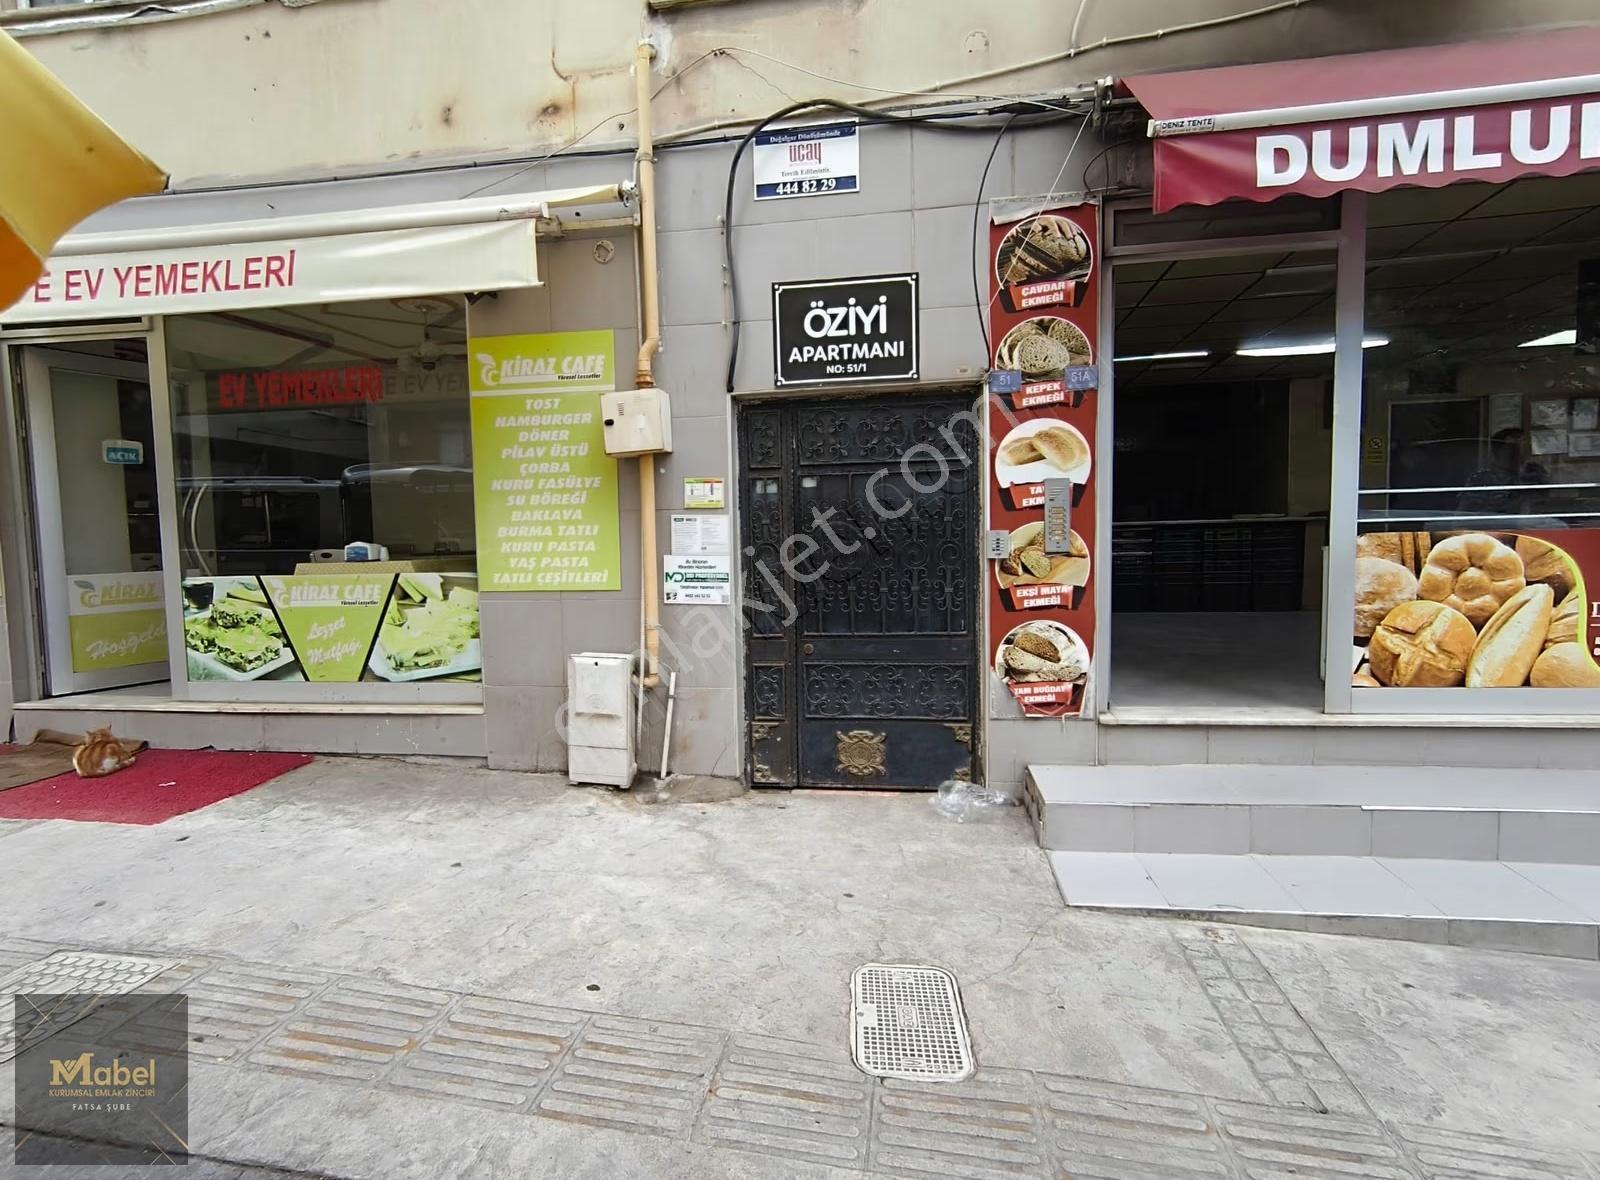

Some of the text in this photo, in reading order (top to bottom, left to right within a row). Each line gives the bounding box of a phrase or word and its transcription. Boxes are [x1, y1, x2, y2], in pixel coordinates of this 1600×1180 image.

[1187, 118, 1213, 127] TENTE
[776, 178, 837, 196] 444 82 29
[64, 268, 105, 301] EV
[113, 249, 296, 298] YEMEKLERİ
[1021, 290, 1065, 308] EKMEĞİ
[803, 295, 888, 339] ÖZİYİ
[788, 341, 906, 364] APARTMANI
[501, 354, 605, 377] KİRAZ CAFE
[826, 363, 867, 374] NO: 51/1
[999, 375, 1011, 386] 51
[1071, 371, 1091, 383] 51A
[1025, 382, 1061, 394] KEPEK
[525, 398, 561, 410] TOST
[1022, 391, 1064, 406] EKMEĞİ
[495, 412, 593, 427] HAMBURGER
[518, 428, 570, 442] DÖNER
[502, 441, 590, 459] PİLAV ÜSTÜ
[519, 462, 571, 476] ÇORBA
[490, 474, 602, 491] KURU FASÜLYE
[506, 489, 588, 506] SU BÖREĞİ
[511, 509, 583, 522] BAKLAVA
[497, 524, 600, 538] BURMA TATLI
[500, 540, 597, 553] KURU PASTA
[509, 556, 590, 571] YAŞ PASTA
[493, 568, 609, 586] TATLI ÇEŞİTLERİ
[100, 580, 158, 600] KİRAZ
[289, 581, 382, 600] KİRAZ CAFE
[1016, 585, 1068, 598] EKŞİ MAYA
[1023, 594, 1061, 608] EKMEĞİ
[1033, 684, 1066, 694] BUĞDAY
[1024, 694, 1057, 703] EKMEĞİ
